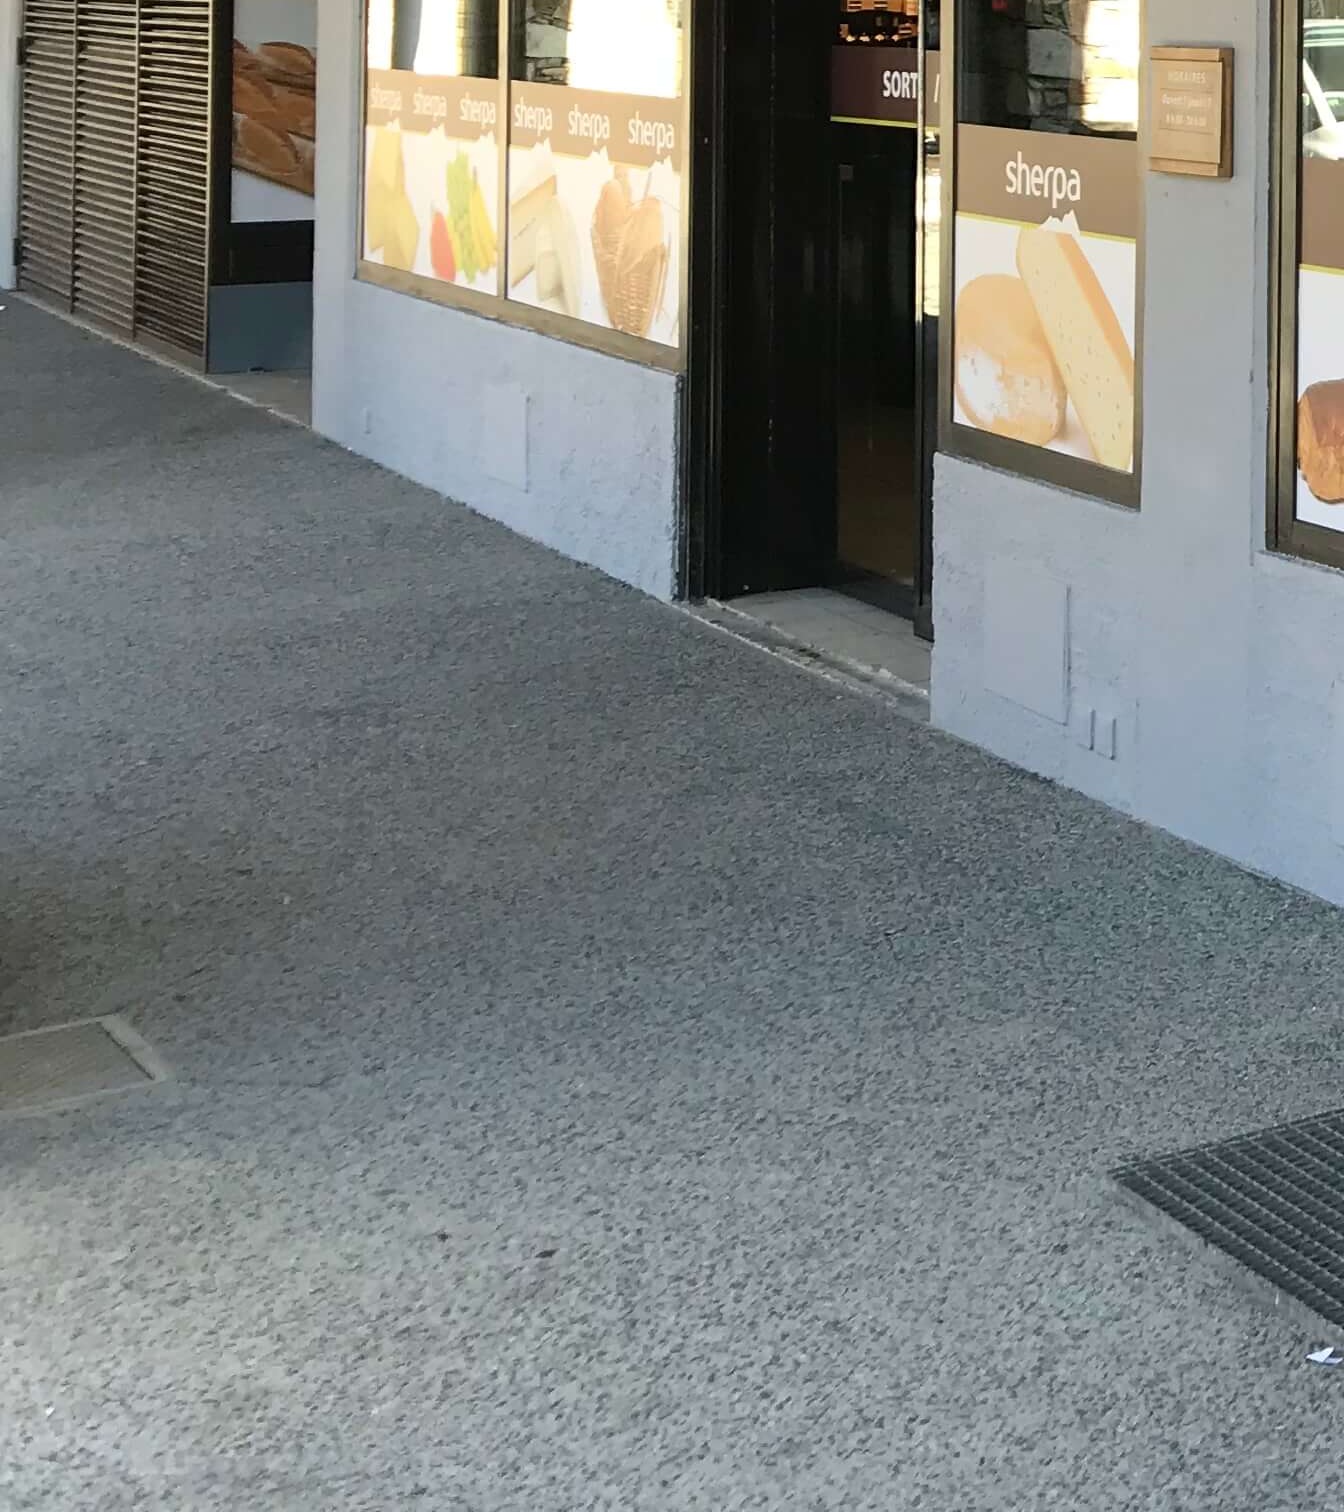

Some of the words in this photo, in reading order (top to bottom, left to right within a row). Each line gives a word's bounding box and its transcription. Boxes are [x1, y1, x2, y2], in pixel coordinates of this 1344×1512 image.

[459, 91, 496, 130] sherpa
[514, 96, 553, 137] sherpa
[567, 103, 610, 144] sherpa
[628, 110, 675, 155] sherpa
[1006, 150, 1081, 209] sherpa
